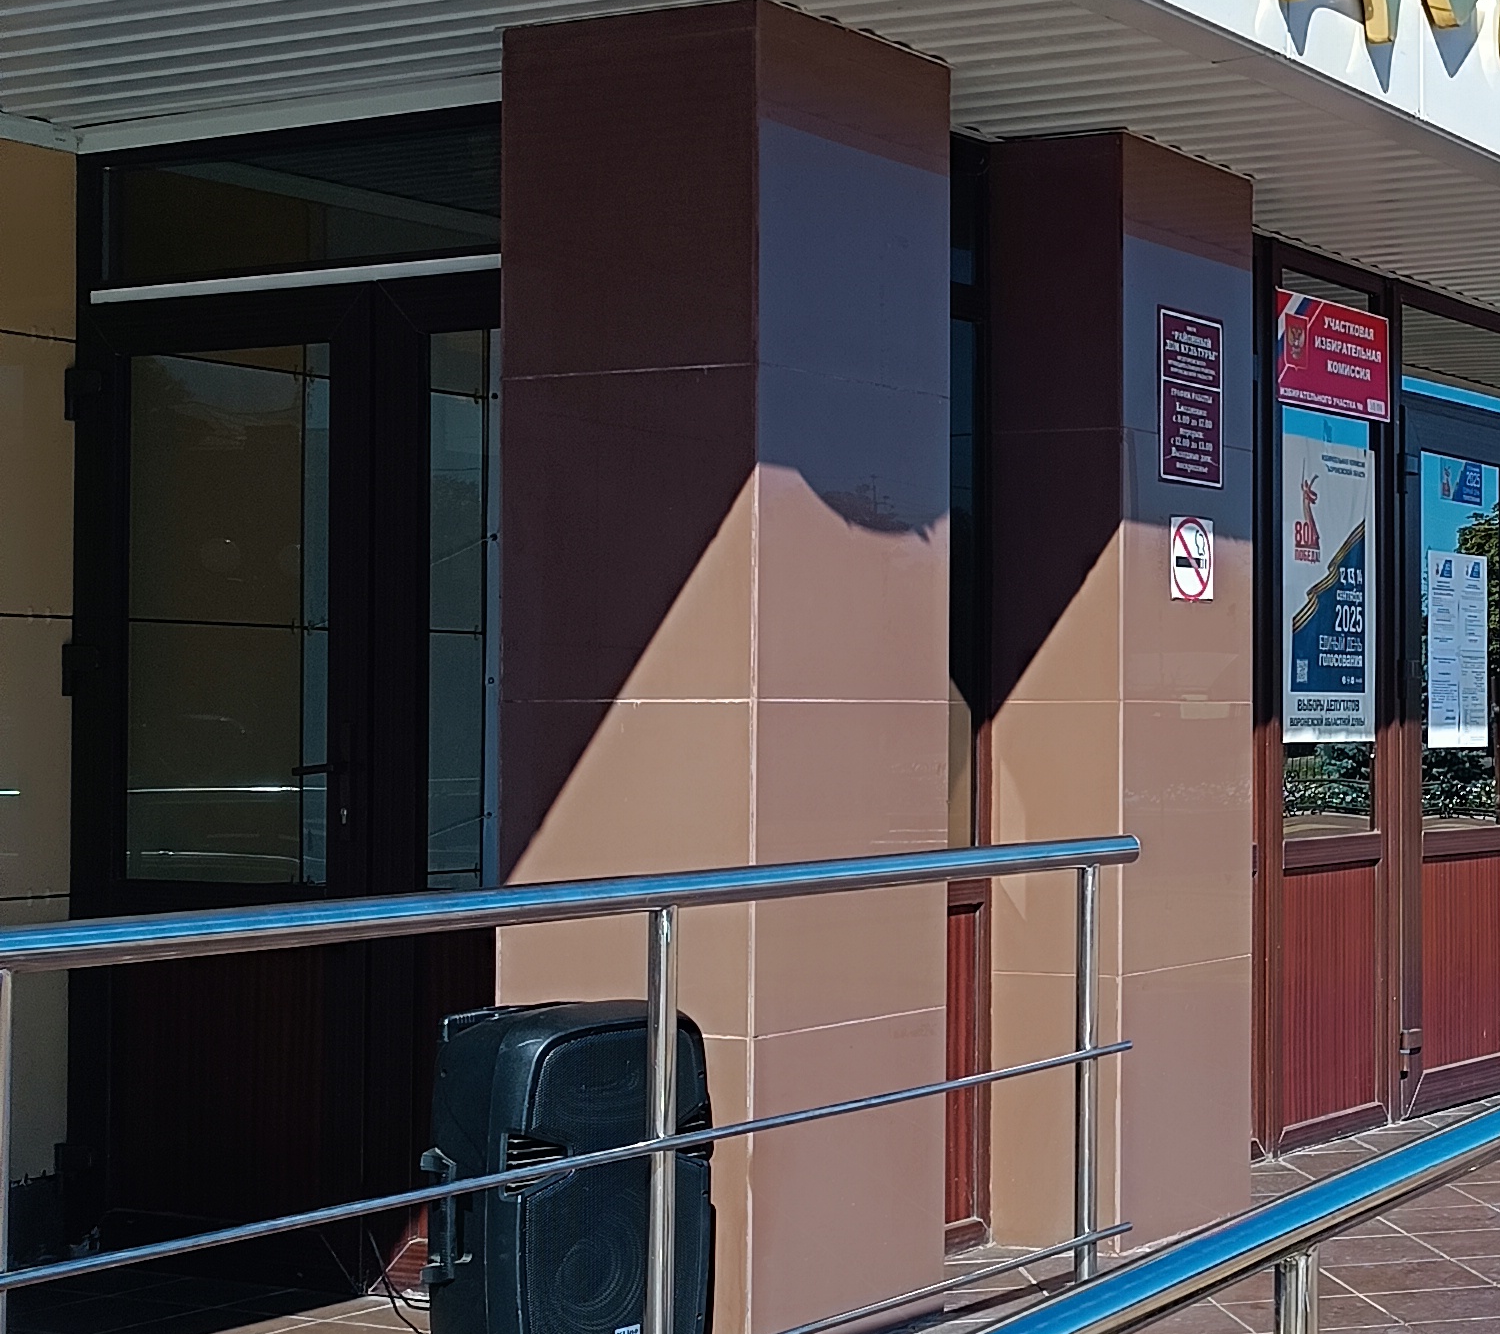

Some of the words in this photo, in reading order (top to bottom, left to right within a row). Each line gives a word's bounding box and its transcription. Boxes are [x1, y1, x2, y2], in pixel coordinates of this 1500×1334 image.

[1323, 315, 1375, 341] УЧАСТКОВАЯ
[1314, 335, 1382, 364] ИЗБИРАТЕЛЬНАЯ
[1327, 359, 1371, 382] КОМИССИЯ
[1279, 386, 1333, 405] ИЗБИРАТЕЛЬНОГО
[1333, 397, 1357, 409] УЧАСТКА
[1334, 604, 1363, 633] 2025
[1297, 698, 1325, 712] ВЫБОРЫ
[1325, 699, 1360, 714] ДЕПУТАТОВ
